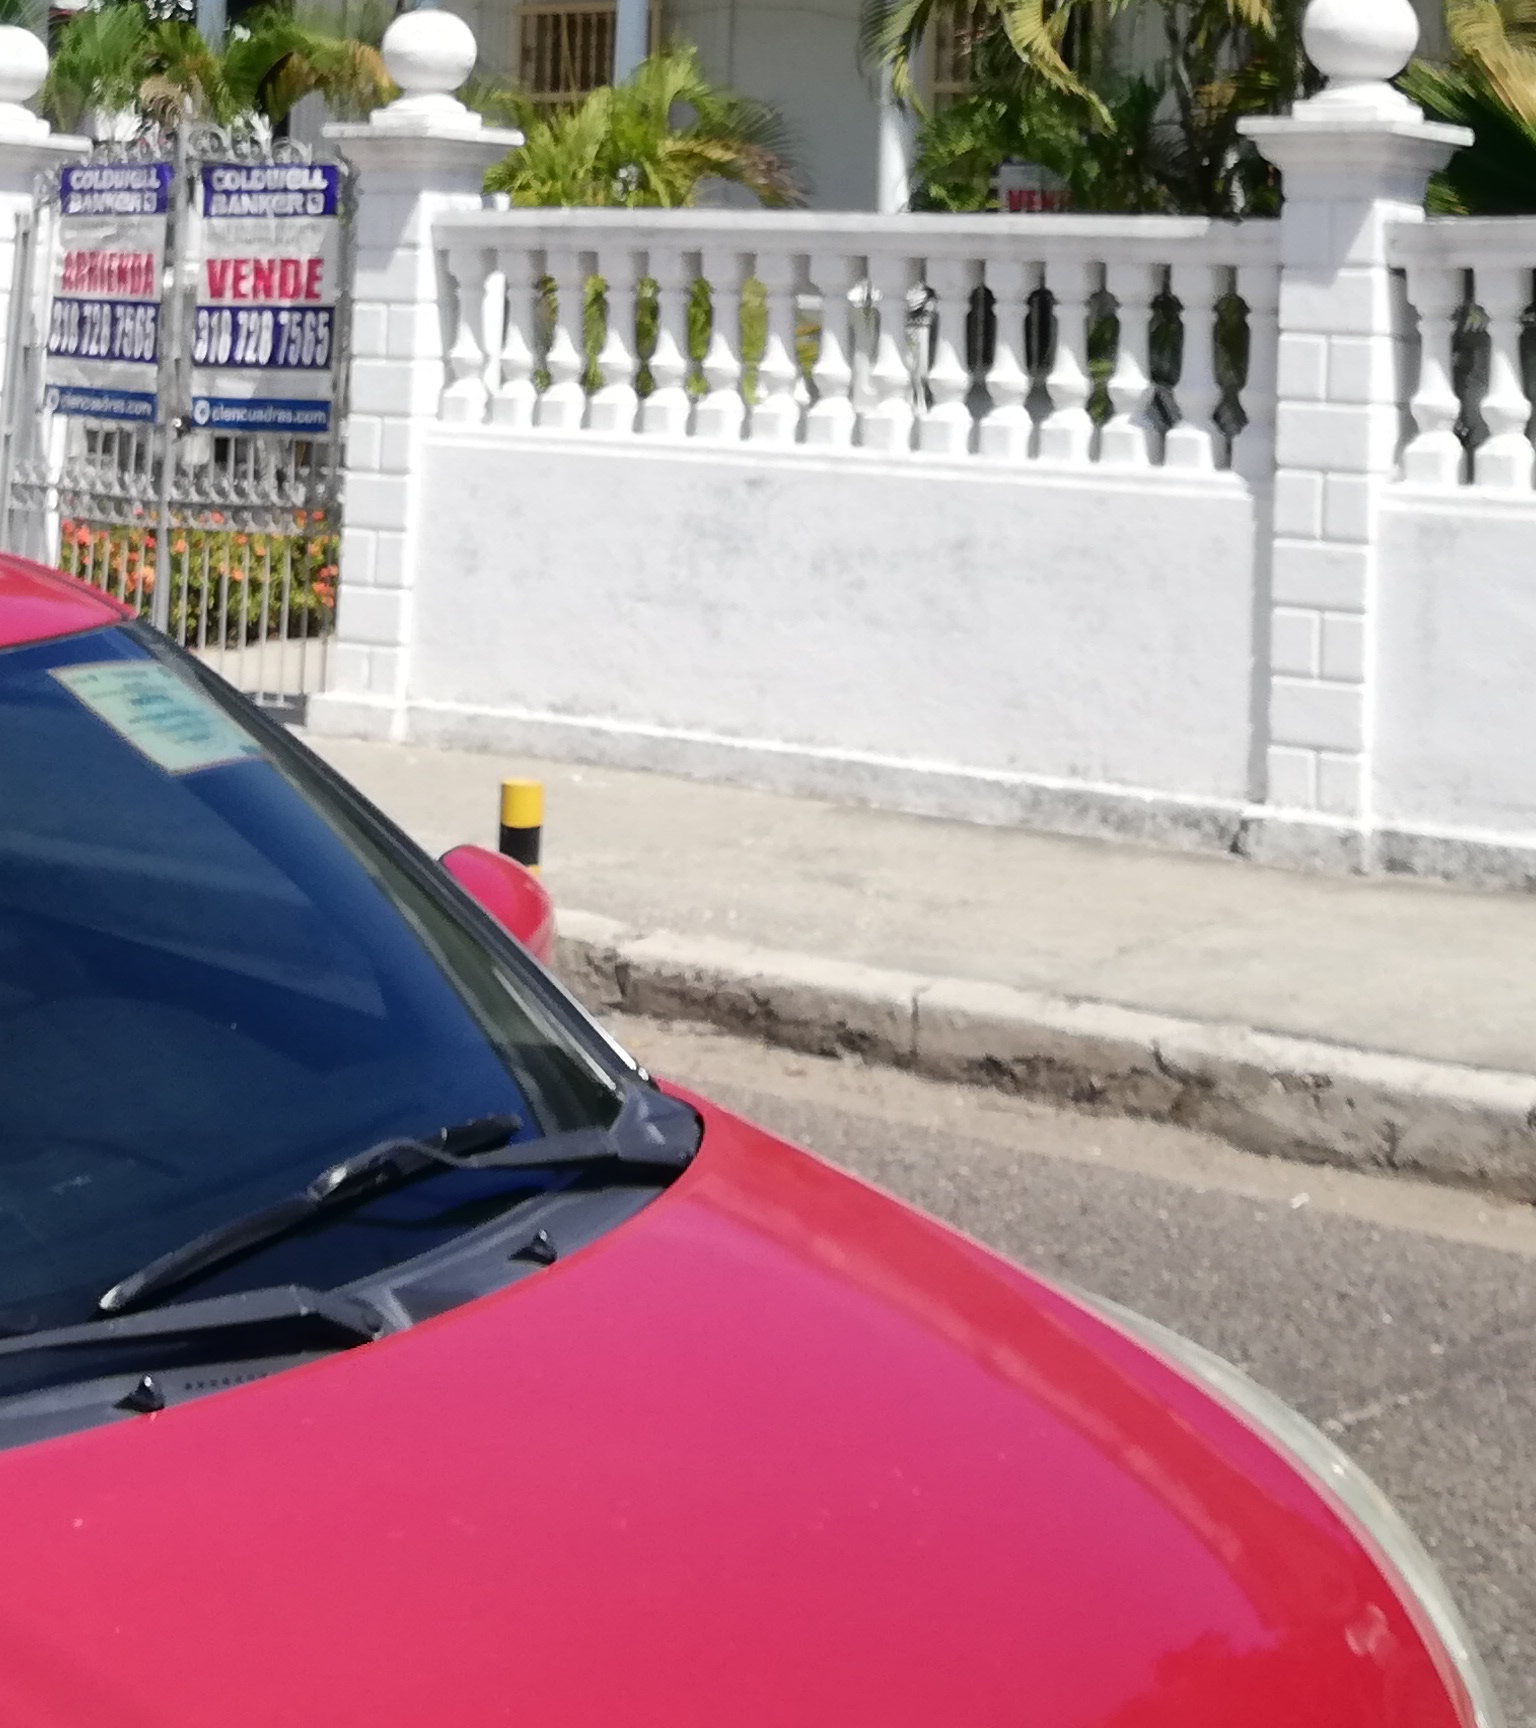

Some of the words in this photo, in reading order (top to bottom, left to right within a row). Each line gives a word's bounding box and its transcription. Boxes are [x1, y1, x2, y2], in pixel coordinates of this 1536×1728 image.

[212, 168, 329, 191] COLDWELL
[211, 192, 305, 214] BANKER
[62, 251, 154, 295] ARRIENDA
[207, 258, 324, 299] VENDE
[114, 305, 156, 360] 7565
[277, 310, 331, 366] 7565
